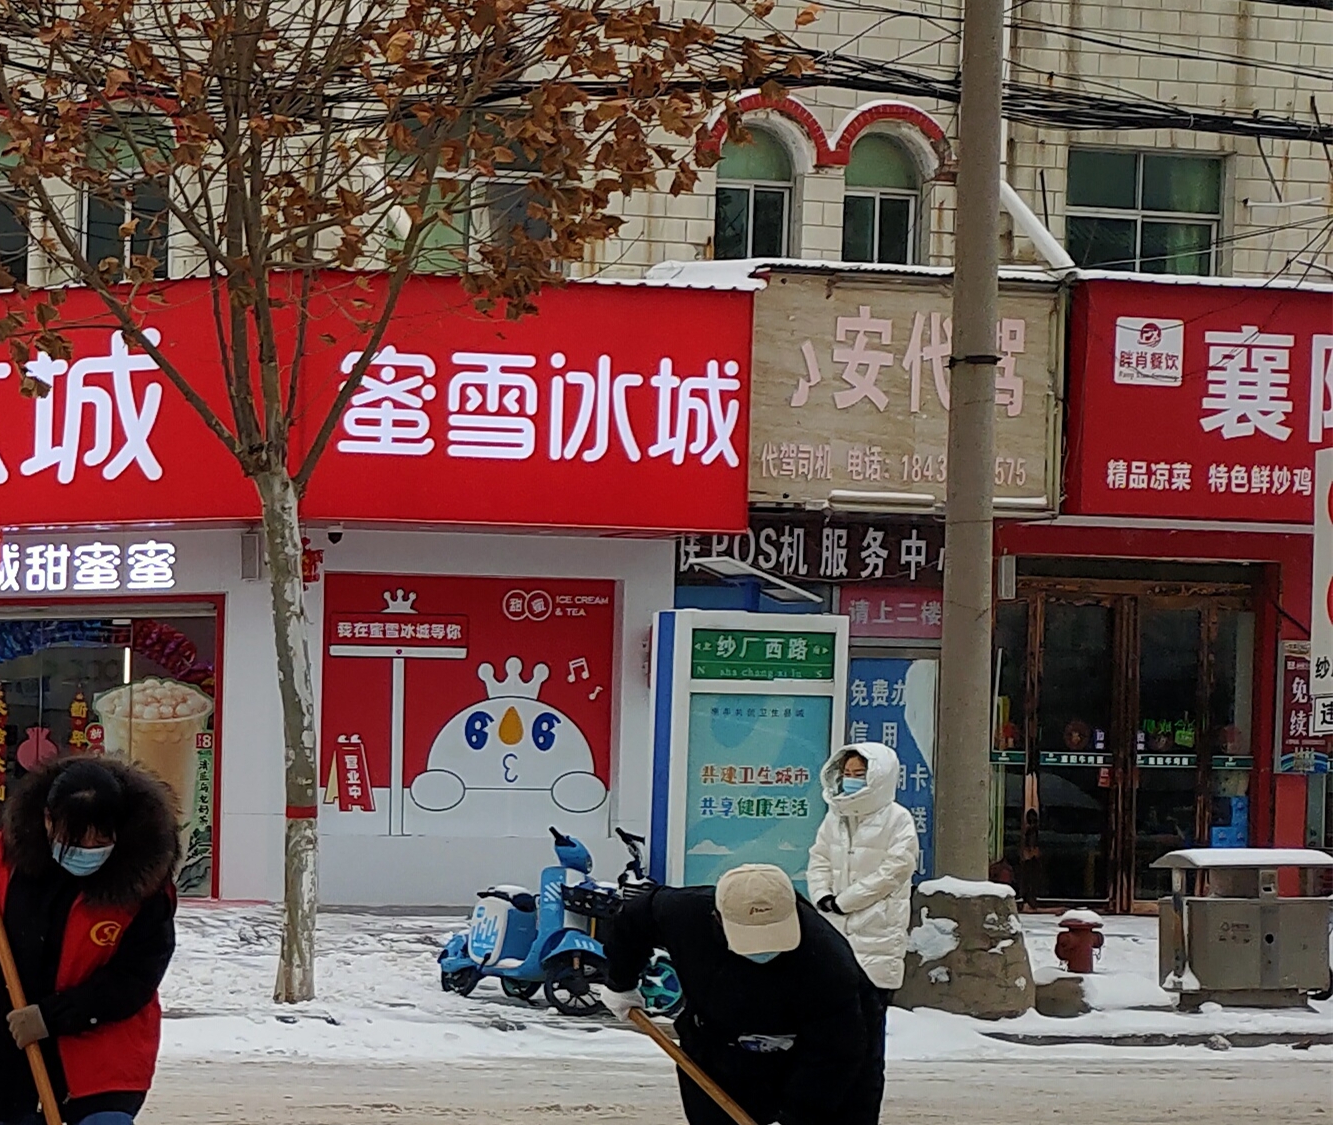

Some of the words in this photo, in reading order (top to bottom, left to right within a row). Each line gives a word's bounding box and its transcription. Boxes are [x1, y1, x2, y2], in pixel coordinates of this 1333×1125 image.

[790, 305, 1026, 417] 安代驾
[338, 345, 739, 468] 蜜雪冰城
[761, 441, 831, 480] 代驾司机
[847, 447, 891, 482] 电话：
[901, 455, 1026, 486] 1843575
[1107, 459, 1192, 490] 精品凉菜
[1208, 463, 1313, 496] 特色鲜炒鸡
[555, 595, 572, 604] ICE
[565, 608, 586, 616] TEA
[849, 599, 942, 625] 请上二楼
[337, 622, 462, 640] 我在蜜雪冰城等你
[716, 635, 810, 661] 纱厂西路
[696, 666, 706, 675] N
[1315, 656, 1333, 680] 纱
[850, 678, 907, 707] 免费办
[701, 765, 810, 786] 共建卫生城市
[699, 797, 809, 818] 共享健康生活
